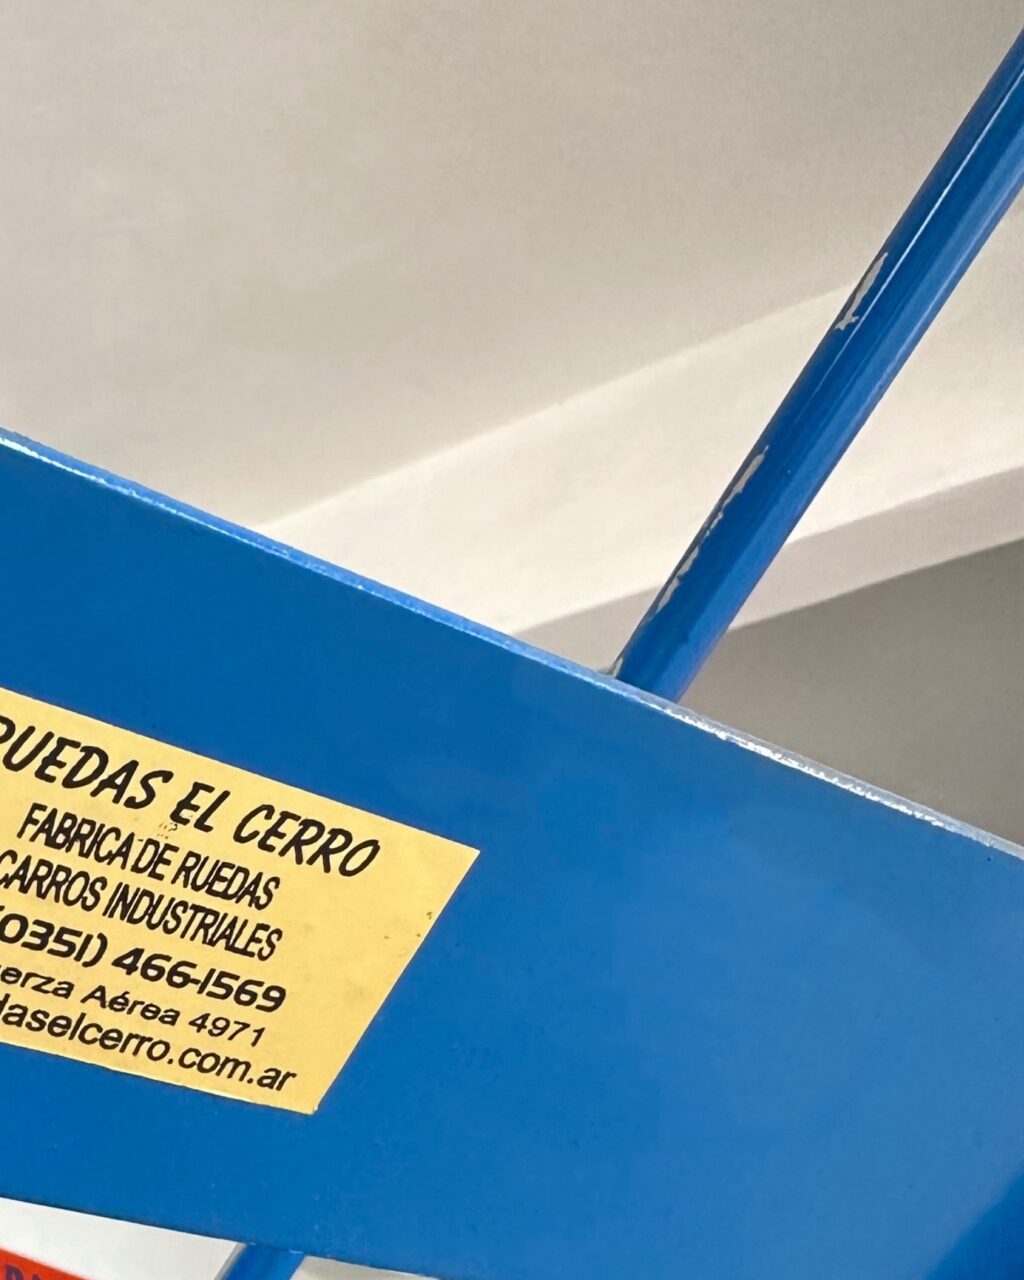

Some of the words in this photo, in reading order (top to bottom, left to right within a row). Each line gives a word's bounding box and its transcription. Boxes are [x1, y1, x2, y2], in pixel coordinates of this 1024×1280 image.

[17, 803, 128, 869] FABRICA
[131, 838, 179, 881] DE
[171, 851, 280, 910] RUEDAS
[170, 782, 230, 832] EL
[233, 805, 380, 876] CERRO
[103, 882, 282, 961] INDUSTRIALES
[81, 985, 180, 1026] Aérea
[189, 1014, 266, 1048] 4971
[112, 948, 286, 1012] 466-1569
